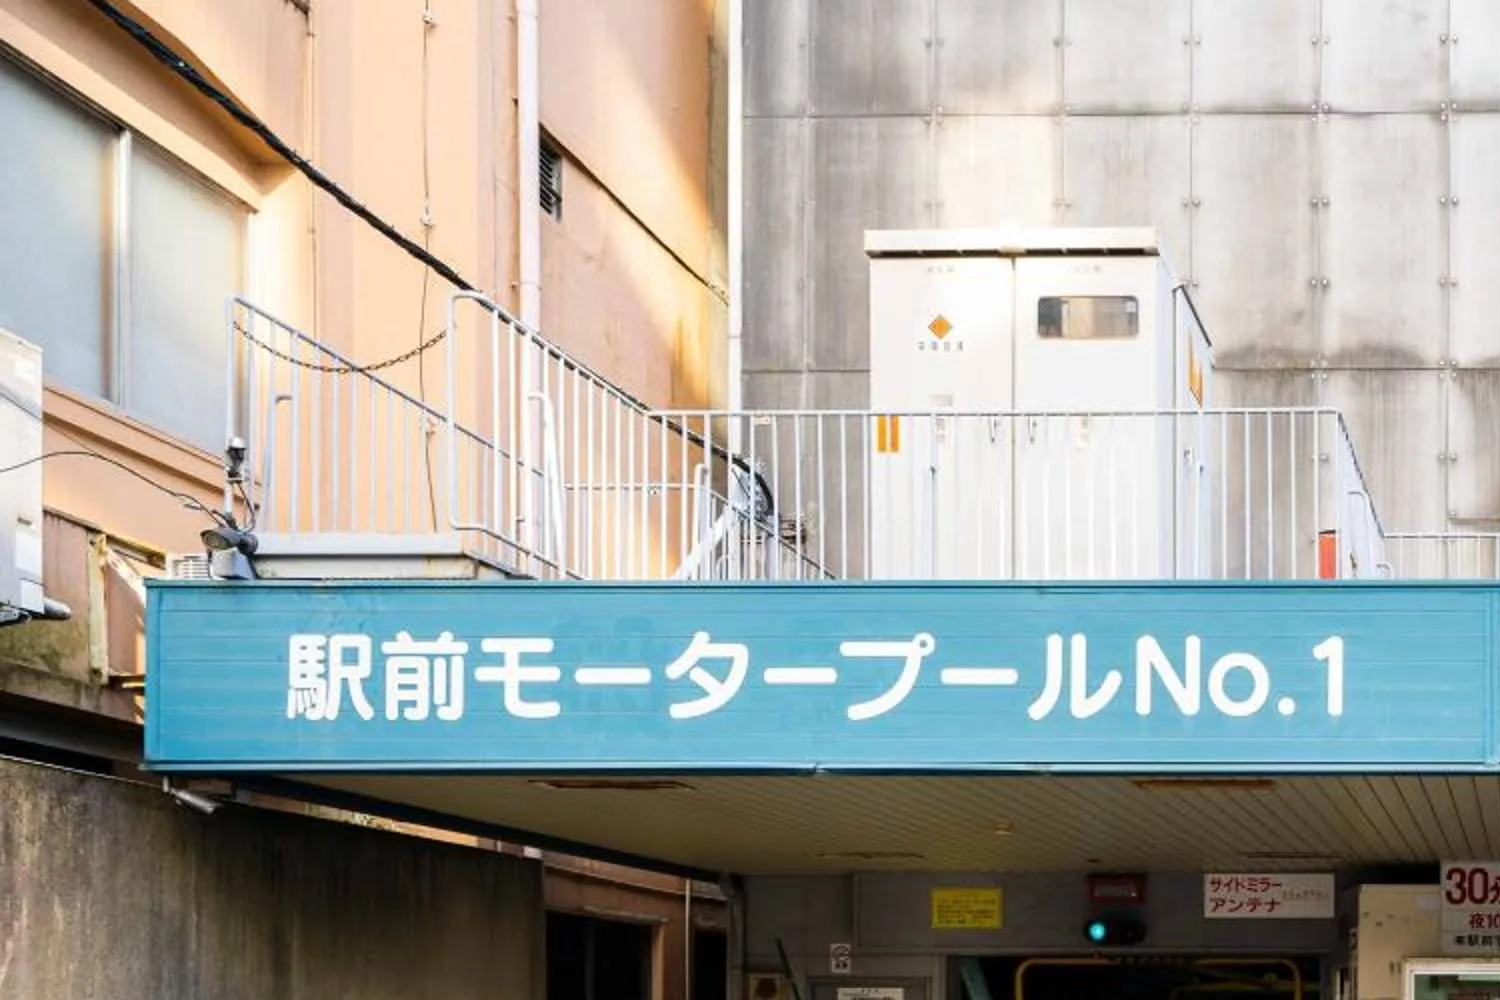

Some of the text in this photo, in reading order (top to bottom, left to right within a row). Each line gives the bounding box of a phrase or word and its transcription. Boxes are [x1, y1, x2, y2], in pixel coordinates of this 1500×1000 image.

[285, 632, 1346, 722] 駅前モータープールNo.1
[1209, 876, 1282, 892] サイドミラー
[1209, 896, 1281, 912] アンテナ
